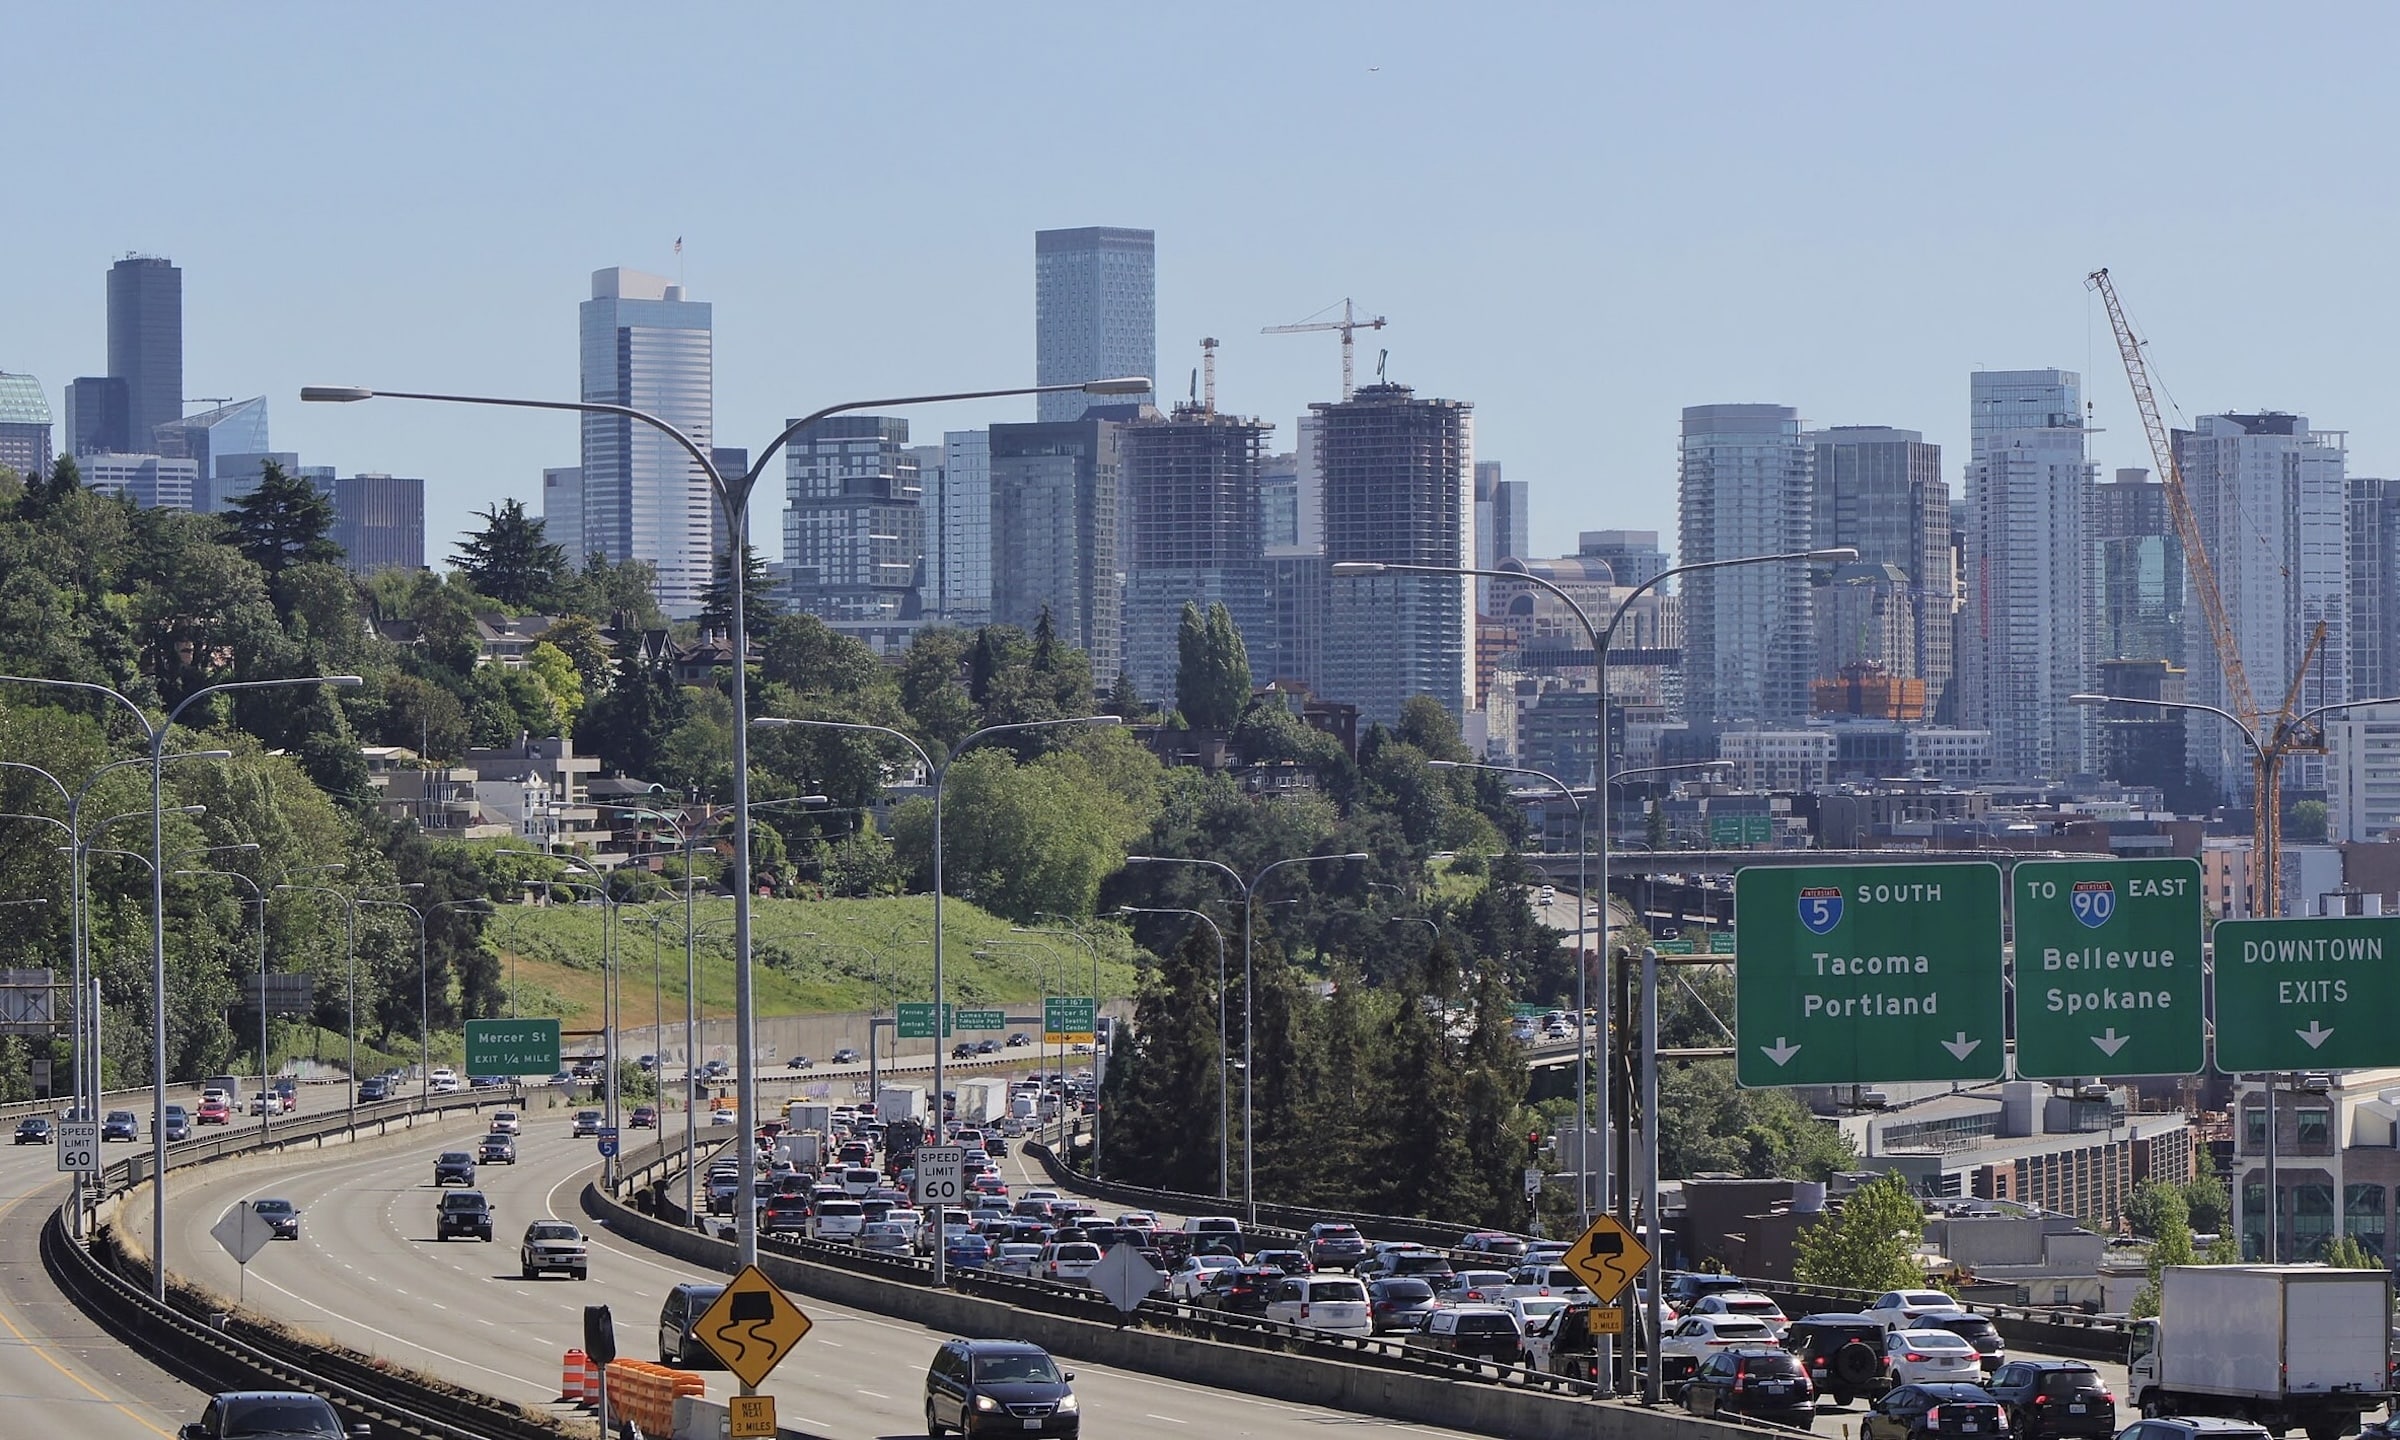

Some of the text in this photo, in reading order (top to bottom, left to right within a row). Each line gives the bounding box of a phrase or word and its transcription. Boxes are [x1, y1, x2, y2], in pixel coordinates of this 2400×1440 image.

[1804, 888, 1837, 897] INTERSTATE
[2028, 879, 2187, 899] TO EAST
[2076, 883, 2109, 891] INTERSTATE
[1858, 884, 1941, 903] SOUTH
[2075, 893, 2110, 918] 90
[1813, 900, 1829, 925] 5
[2244, 938, 2382, 963] DOWNTOWN
[1812, 953, 1929, 976] Tacoma
[2043, 947, 2175, 971] Bellevue
[2279, 979, 2348, 1004] EXITS
[1804, 992, 1937, 1017] Portland
[2047, 987, 2171, 1016] Spokane
[1079, 1008, 1088, 1016] St
[478, 1032, 547, 1043] Mercer St
[475, 1055, 498, 1063] EXIT
[524, 1054, 551, 1062] MILE
[61, 1127, 95, 1136] SPEED
[64, 1139, 90, 1148] LIMIT
[604, 1142, 612, 1155] 5
[65, 1151, 90, 1166] 60
[921, 1153, 959, 1163] SPEED
[925, 1166, 954, 1176] LIMIT
[925, 1181, 955, 1198] 60
[1598, 1311, 1613, 1319] NEXT
[1593, 1321, 1619, 1330] 3 MILES
[742, 1401, 762, 1410] NEXT
[736, 1421, 771, 1432] 3 MILES
